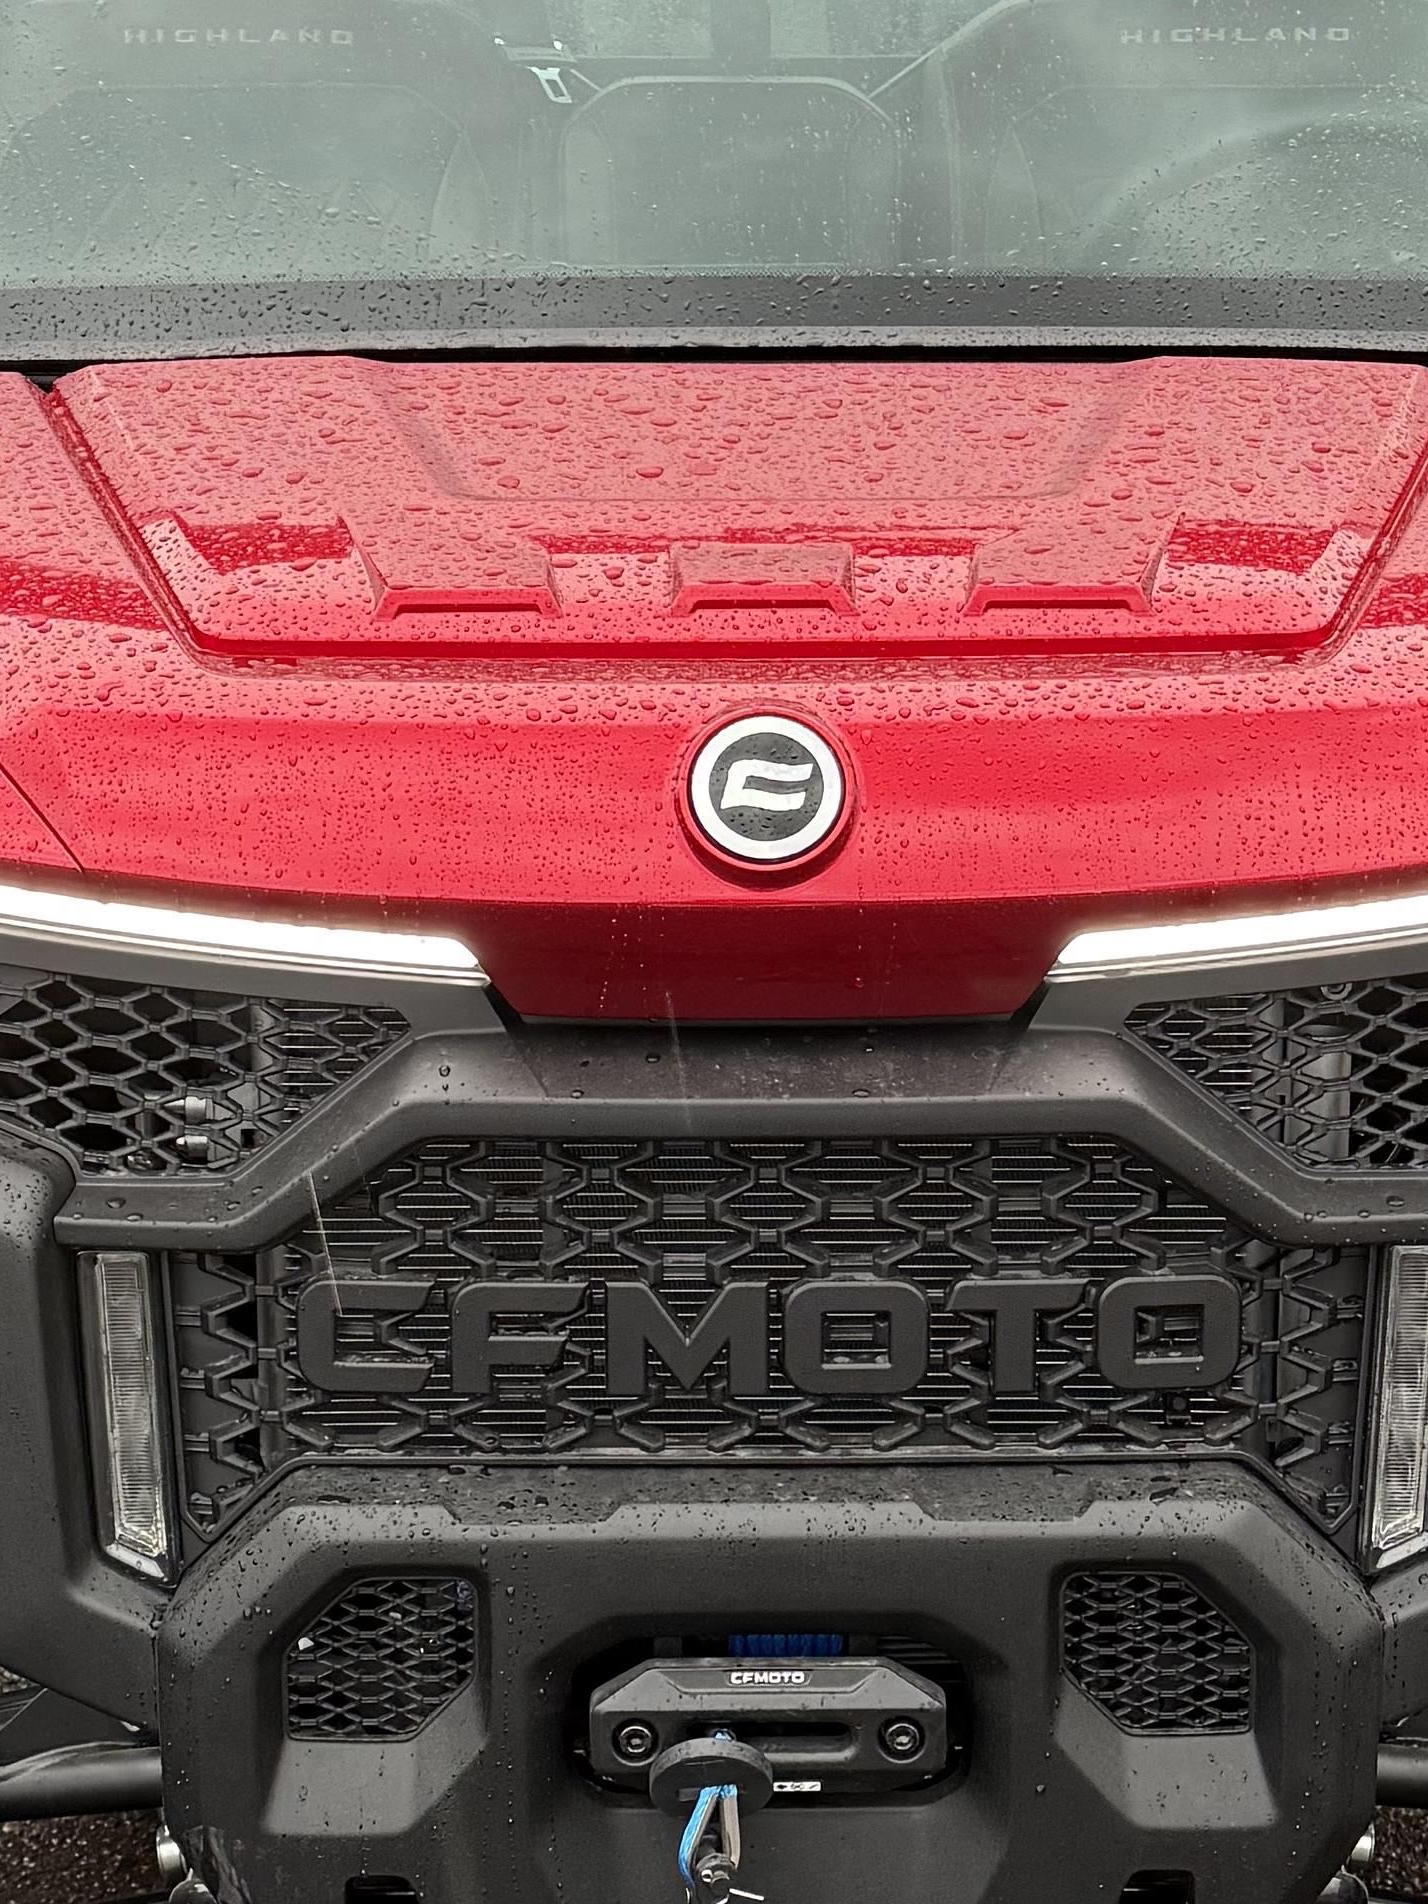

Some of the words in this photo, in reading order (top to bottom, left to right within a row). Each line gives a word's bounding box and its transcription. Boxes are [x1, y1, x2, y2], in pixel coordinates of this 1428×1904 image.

[123, 28, 354, 45] HIGHLAND
[1121, 26, 1350, 44] HIGHLAND
[296, 1278, 1243, 1394] CFMOTO
[730, 1670, 806, 1685] CFMOTO
